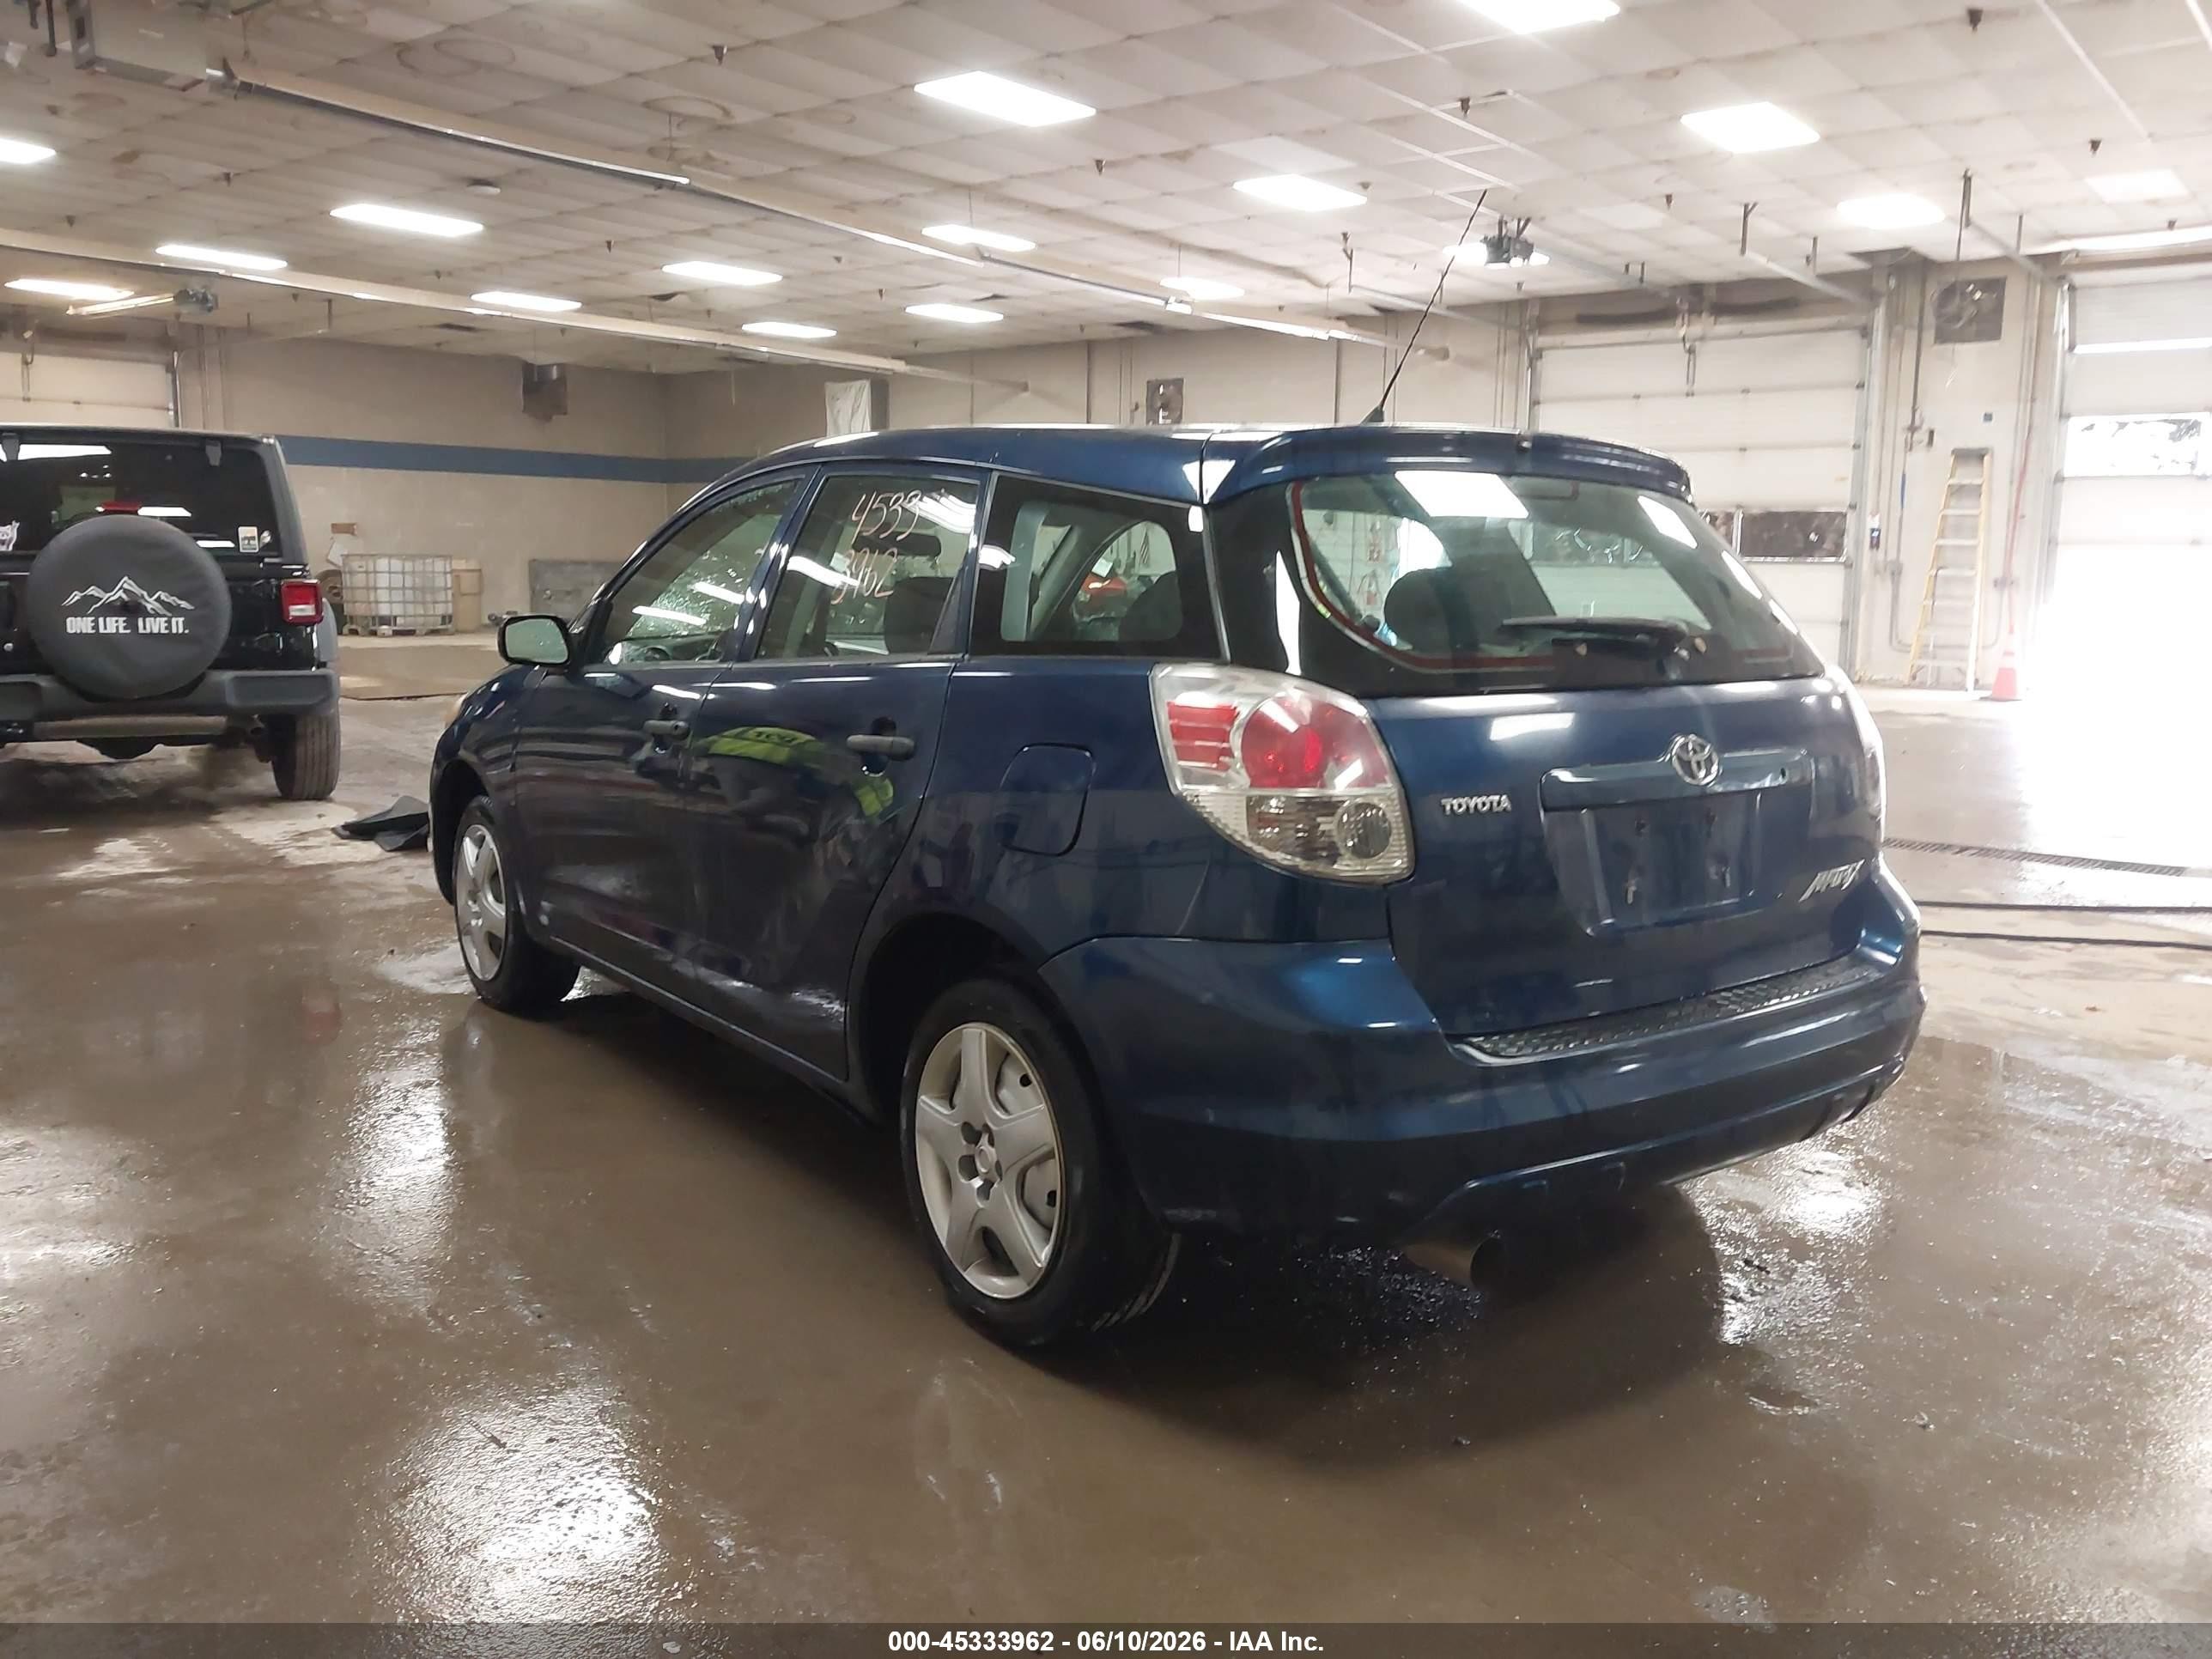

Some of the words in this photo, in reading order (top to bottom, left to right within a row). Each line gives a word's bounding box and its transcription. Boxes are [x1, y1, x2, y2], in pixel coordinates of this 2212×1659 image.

[852, 489, 921, 545] 4533
[65, 617, 95, 634] ONE
[137, 617, 169, 634] LIVE
[171, 617, 190, 634] IT.
[1440, 793, 1512, 816] TOYOTA
